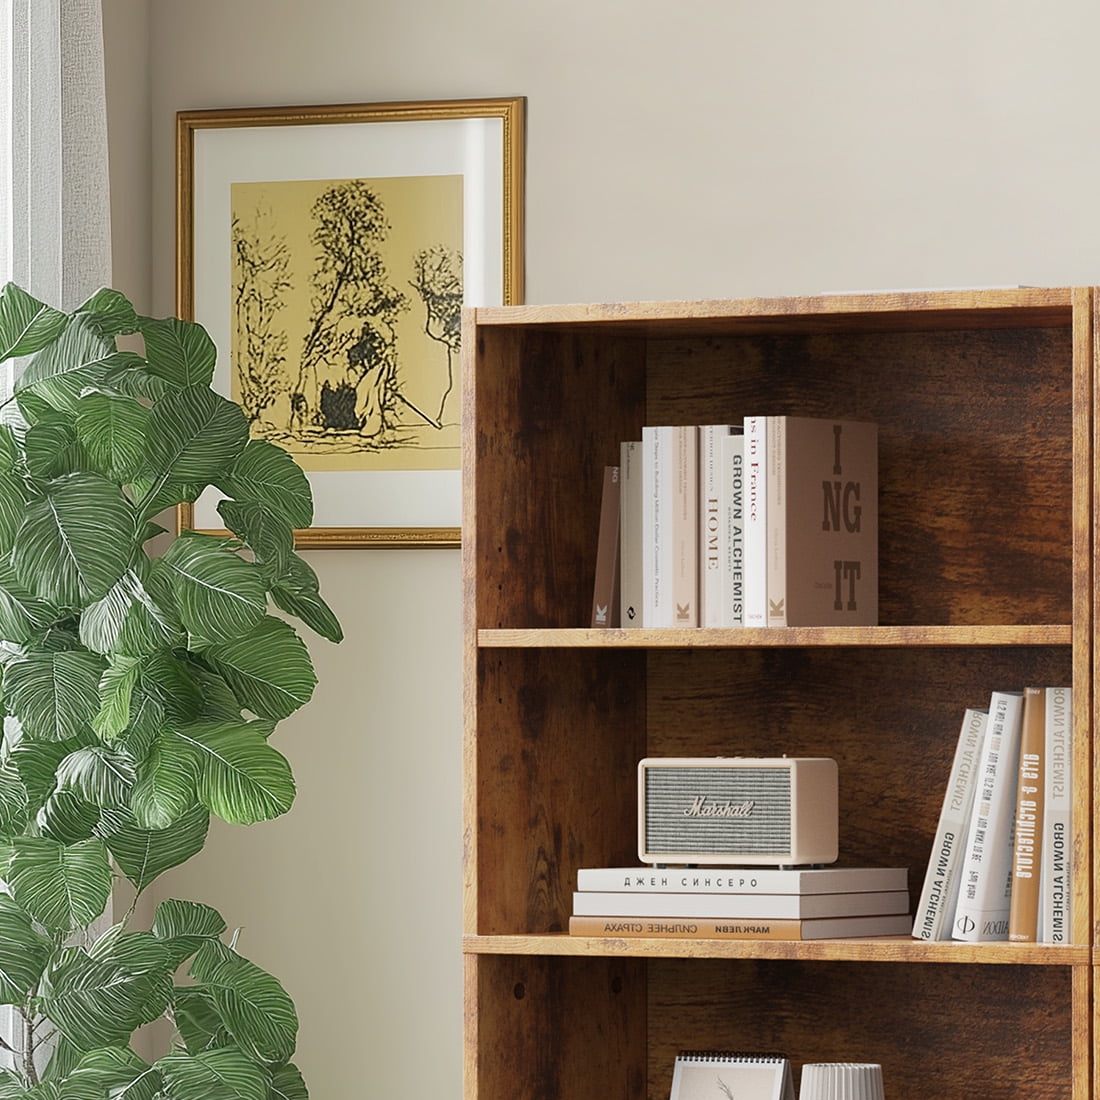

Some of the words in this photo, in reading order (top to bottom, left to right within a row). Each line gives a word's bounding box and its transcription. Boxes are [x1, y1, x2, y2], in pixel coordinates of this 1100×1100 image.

[750, 439, 759, 455] in
[732, 454, 743, 520] GROWN
[750, 462, 759, 521] France
[821, 480, 862, 533] NG
[707, 498, 719, 570] HOME
[732, 525, 743, 625] ALCHEMIST
[833, 560, 862, 611] IT
[684, 795, 755, 817] Marshall
[624, 877, 668, 887] ДЖЕН
[681, 877, 758, 888] СИНСЕРО
